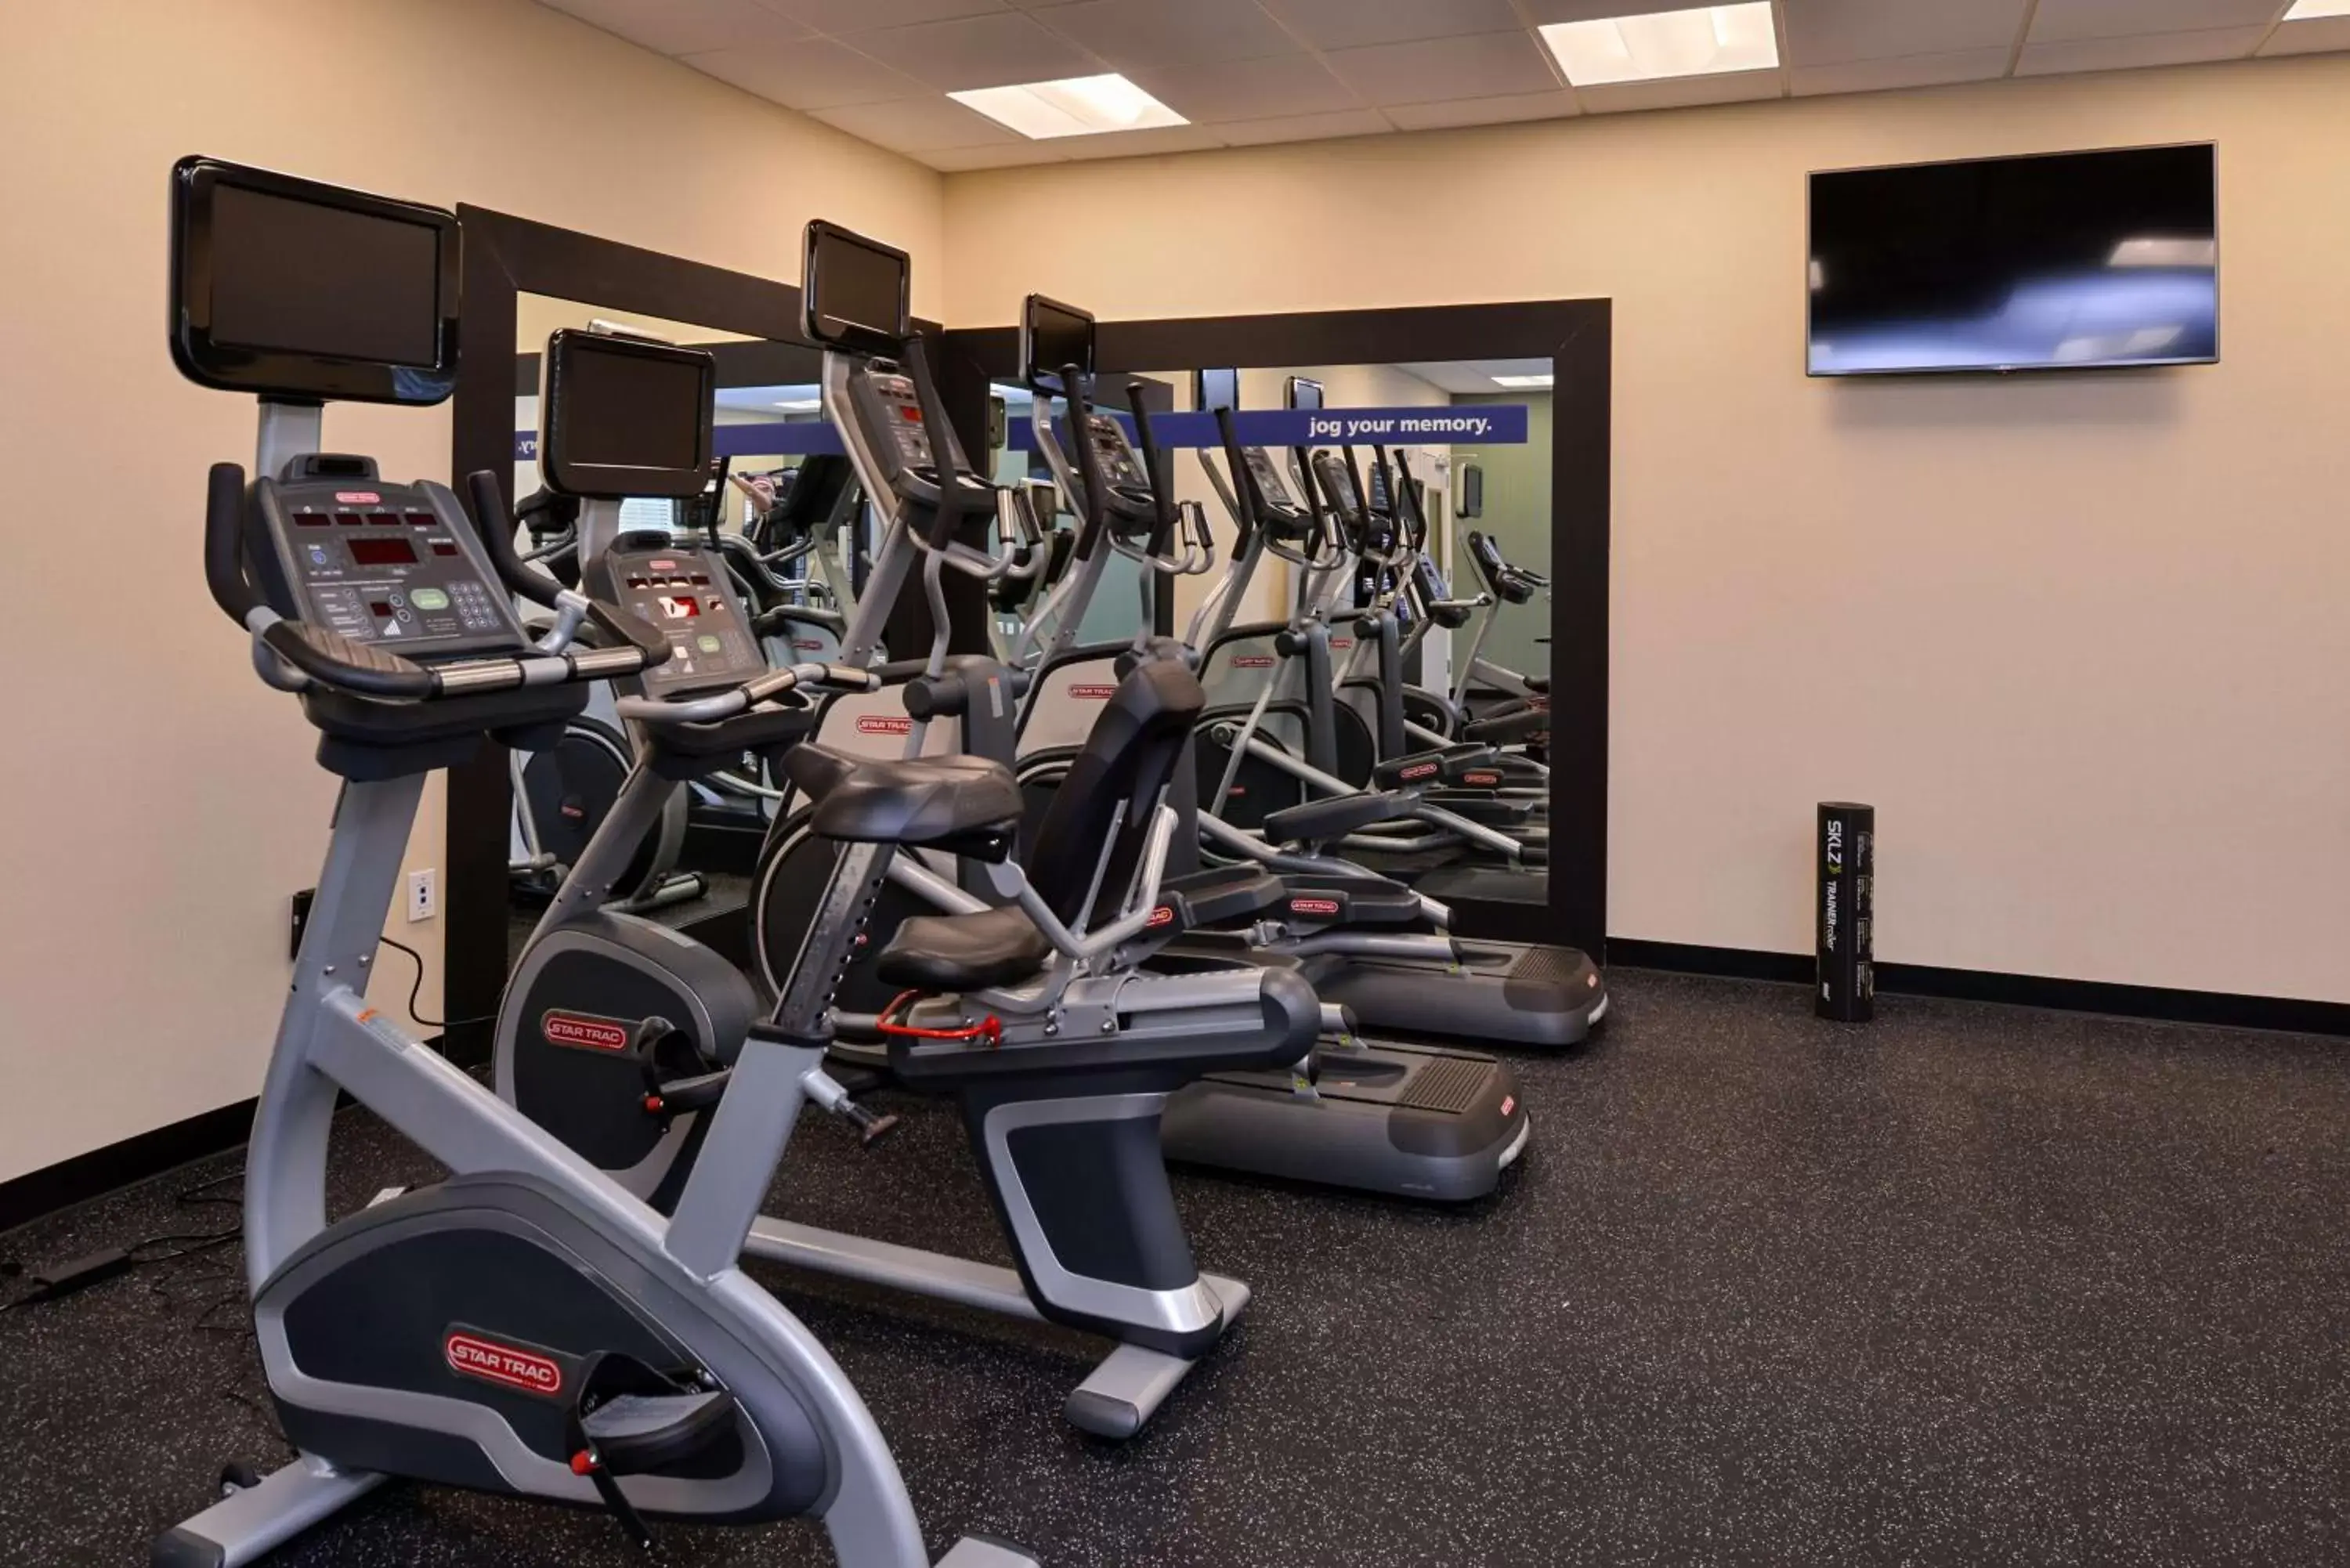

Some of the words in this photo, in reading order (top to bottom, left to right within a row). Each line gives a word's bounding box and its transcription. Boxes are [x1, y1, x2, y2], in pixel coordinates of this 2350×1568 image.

[1308, 417, 1341, 437] jog
[1347, 419, 1395, 436] your
[1400, 417, 1492, 435] memory.
[1828, 820, 1842, 864] SKLZ
[551, 1024, 584, 1036] STAR
[585, 1028, 620, 1042] TRAC
[454, 1344, 501, 1369] STAR
[502, 1357, 552, 1382] TRAC
